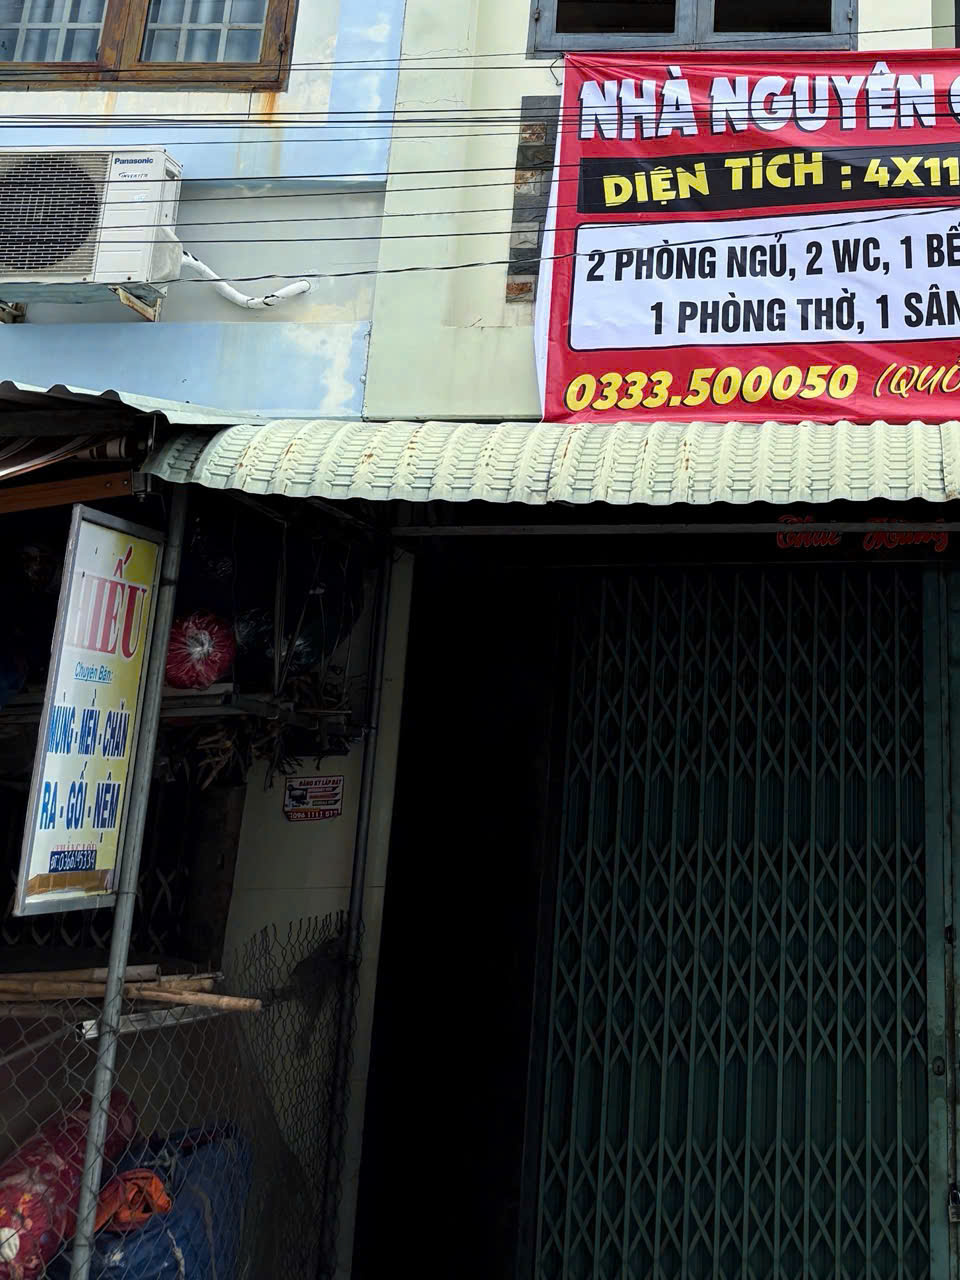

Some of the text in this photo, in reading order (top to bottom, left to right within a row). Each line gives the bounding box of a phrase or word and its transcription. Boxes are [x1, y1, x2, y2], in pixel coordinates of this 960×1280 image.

[578, 66, 698, 139] NHÀ
[711, 61, 937, 132] NGUYÊN
[114, 156, 153, 165] Panasonic
[603, 166, 709, 207] DIỆN
[724, 152, 823, 191] TÍCH
[864, 157, 960, 187] 4X11
[587, 250, 605, 281] 2
[615, 240, 716, 281] PHÒNG
[727, 233, 795, 281] NGỦ,
[806, 241, 823, 276] 2
[833, 237, 890, 275] WC,
[900, 236, 913, 269] 1
[650, 301, 663, 335] 1
[678, 291, 786, 334] PHÒNG
[796, 287, 864, 335] THỜ,
[876, 295, 889, 329] 1
[564, 364, 859, 413] 0333.500050
[66, 761, 88, 830] GỐI
[93, 772, 121, 843] NỆM
